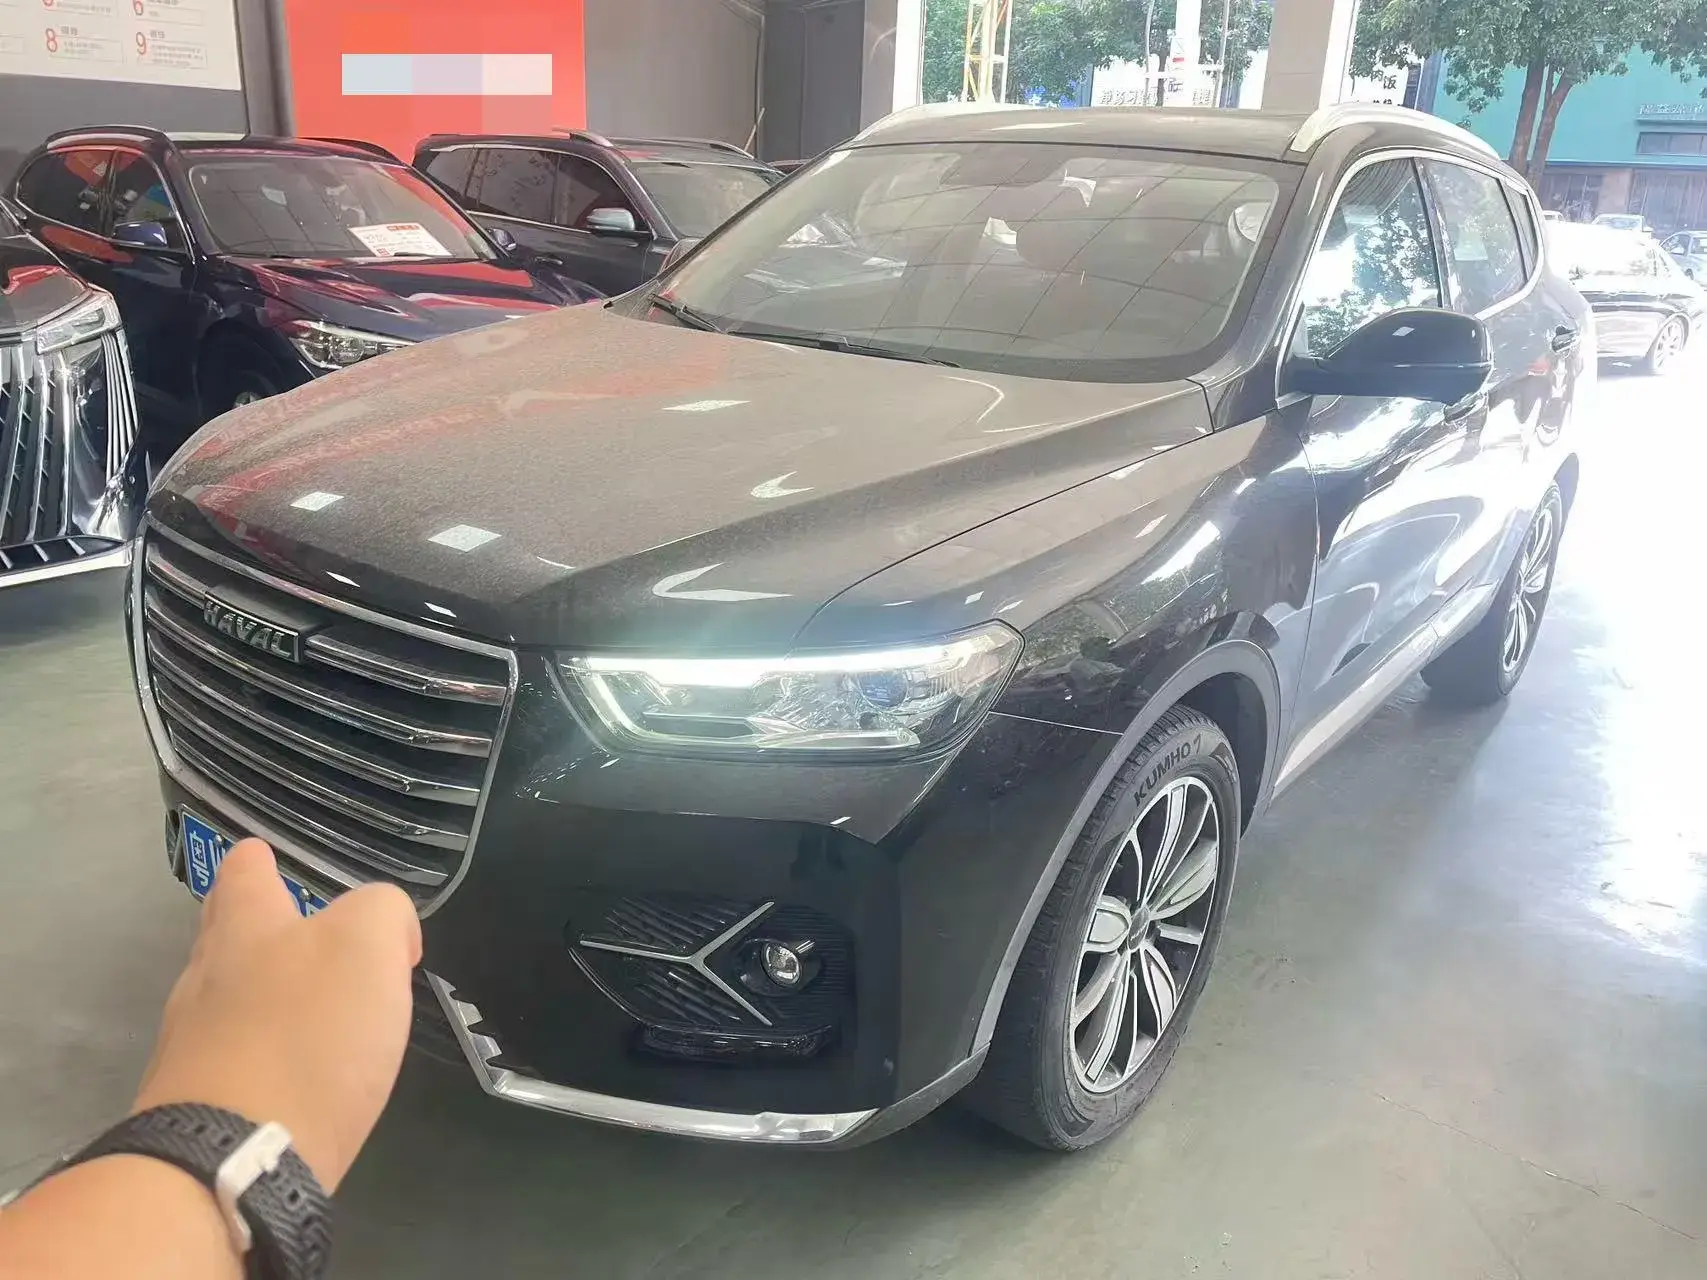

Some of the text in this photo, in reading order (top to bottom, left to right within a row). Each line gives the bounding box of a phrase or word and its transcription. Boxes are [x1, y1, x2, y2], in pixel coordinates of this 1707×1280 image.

[45, 28, 58, 53] 8
[135, 31, 147, 55] 9
[203, 600, 291, 658] HAVAL
[1134, 742, 1191, 807] KUMHO
